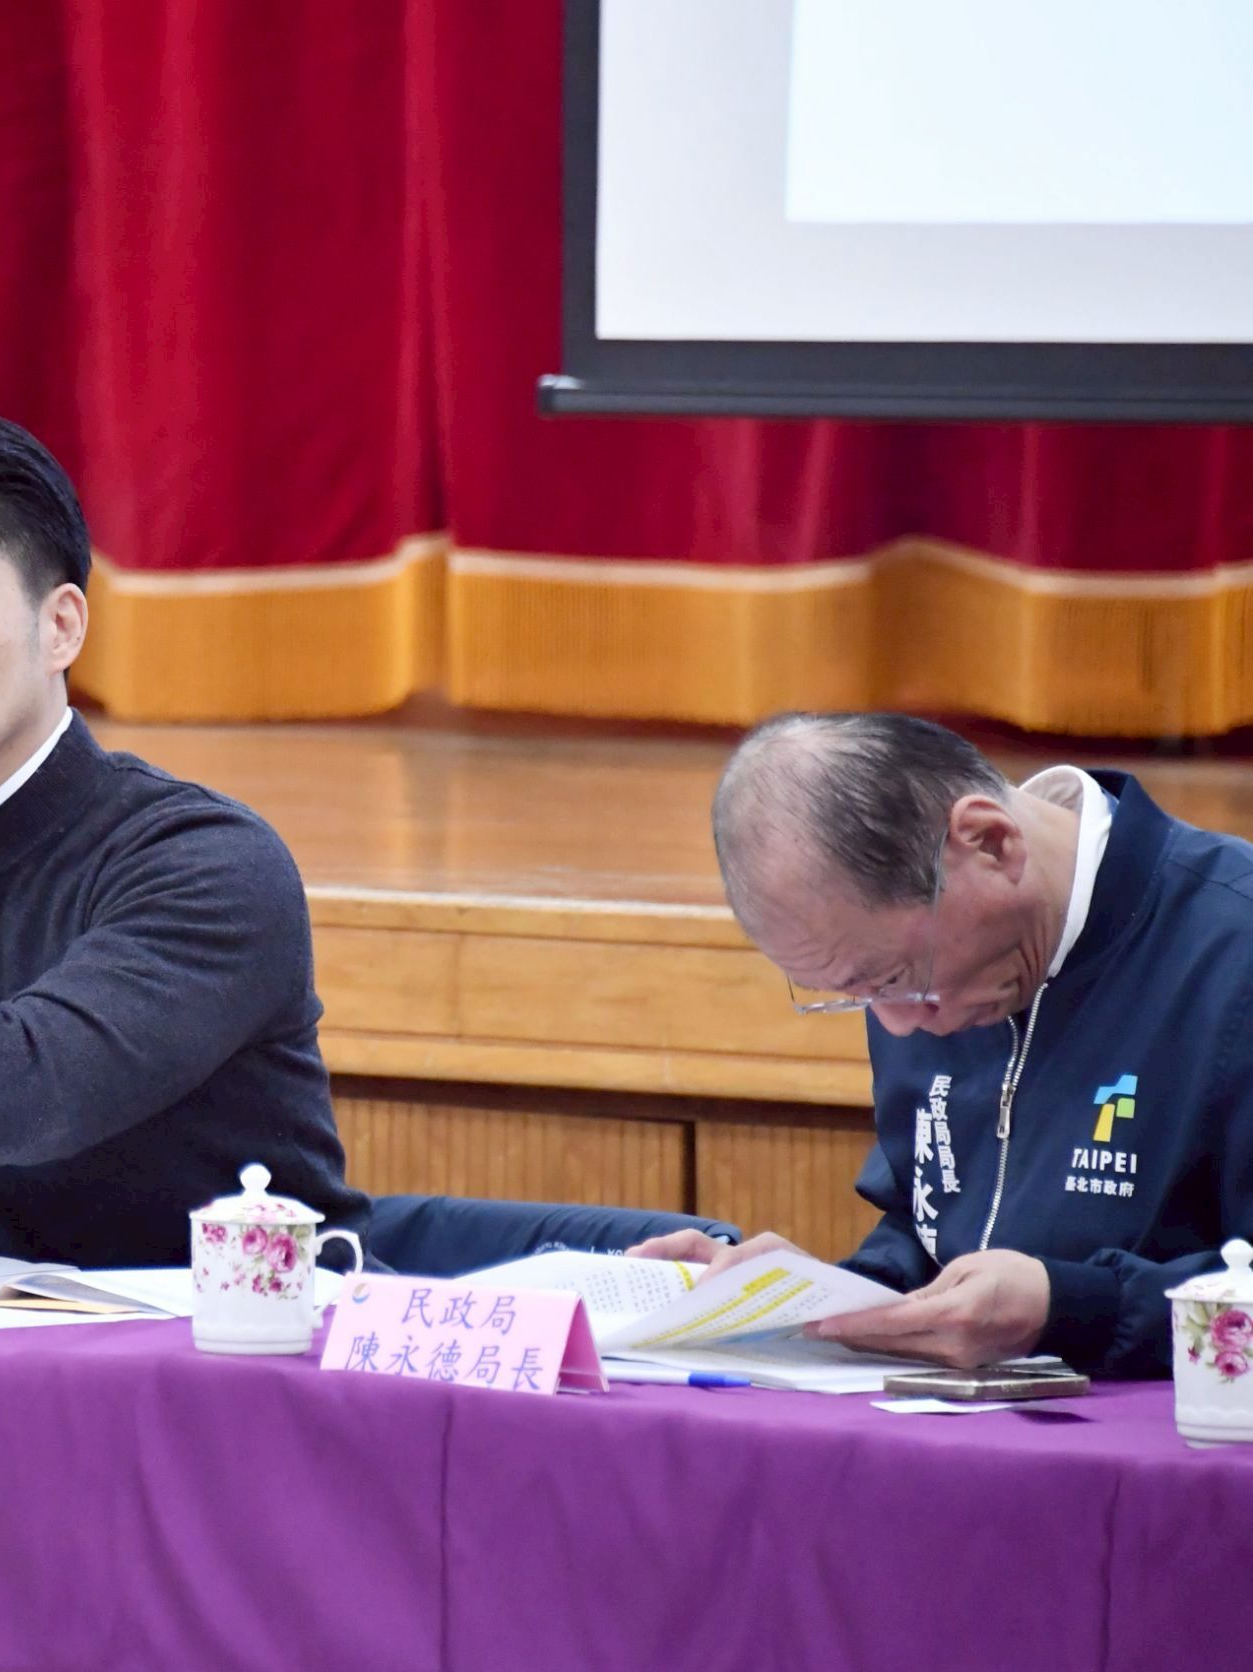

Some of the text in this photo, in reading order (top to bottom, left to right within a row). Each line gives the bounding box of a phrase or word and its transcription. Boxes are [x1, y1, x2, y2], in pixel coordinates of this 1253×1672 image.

[929, 1075, 961, 1193] 民政局局長
[1071, 1148, 1137, 1174] TAIPEI
[1065, 1175, 1135, 1198] 臺北市政府
[401, 1288, 517, 1336] 民政局
[346, 1331, 544, 1392] 陳永德局長
